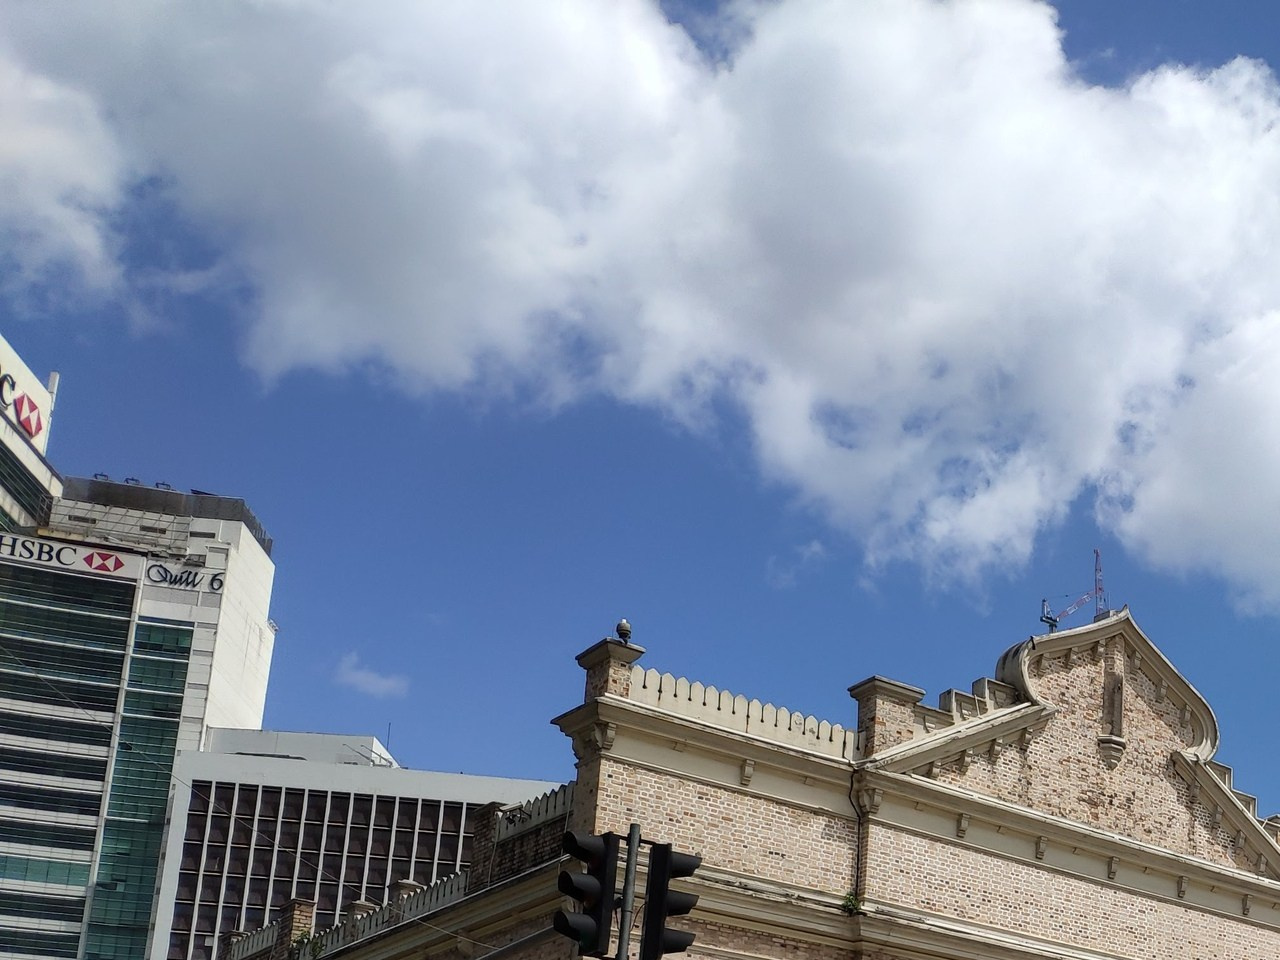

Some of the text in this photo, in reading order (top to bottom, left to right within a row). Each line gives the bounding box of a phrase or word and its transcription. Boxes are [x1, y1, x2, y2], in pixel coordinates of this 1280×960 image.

[0, 534, 78, 567] HSBC
[147, 564, 224, 591] Quill 6
